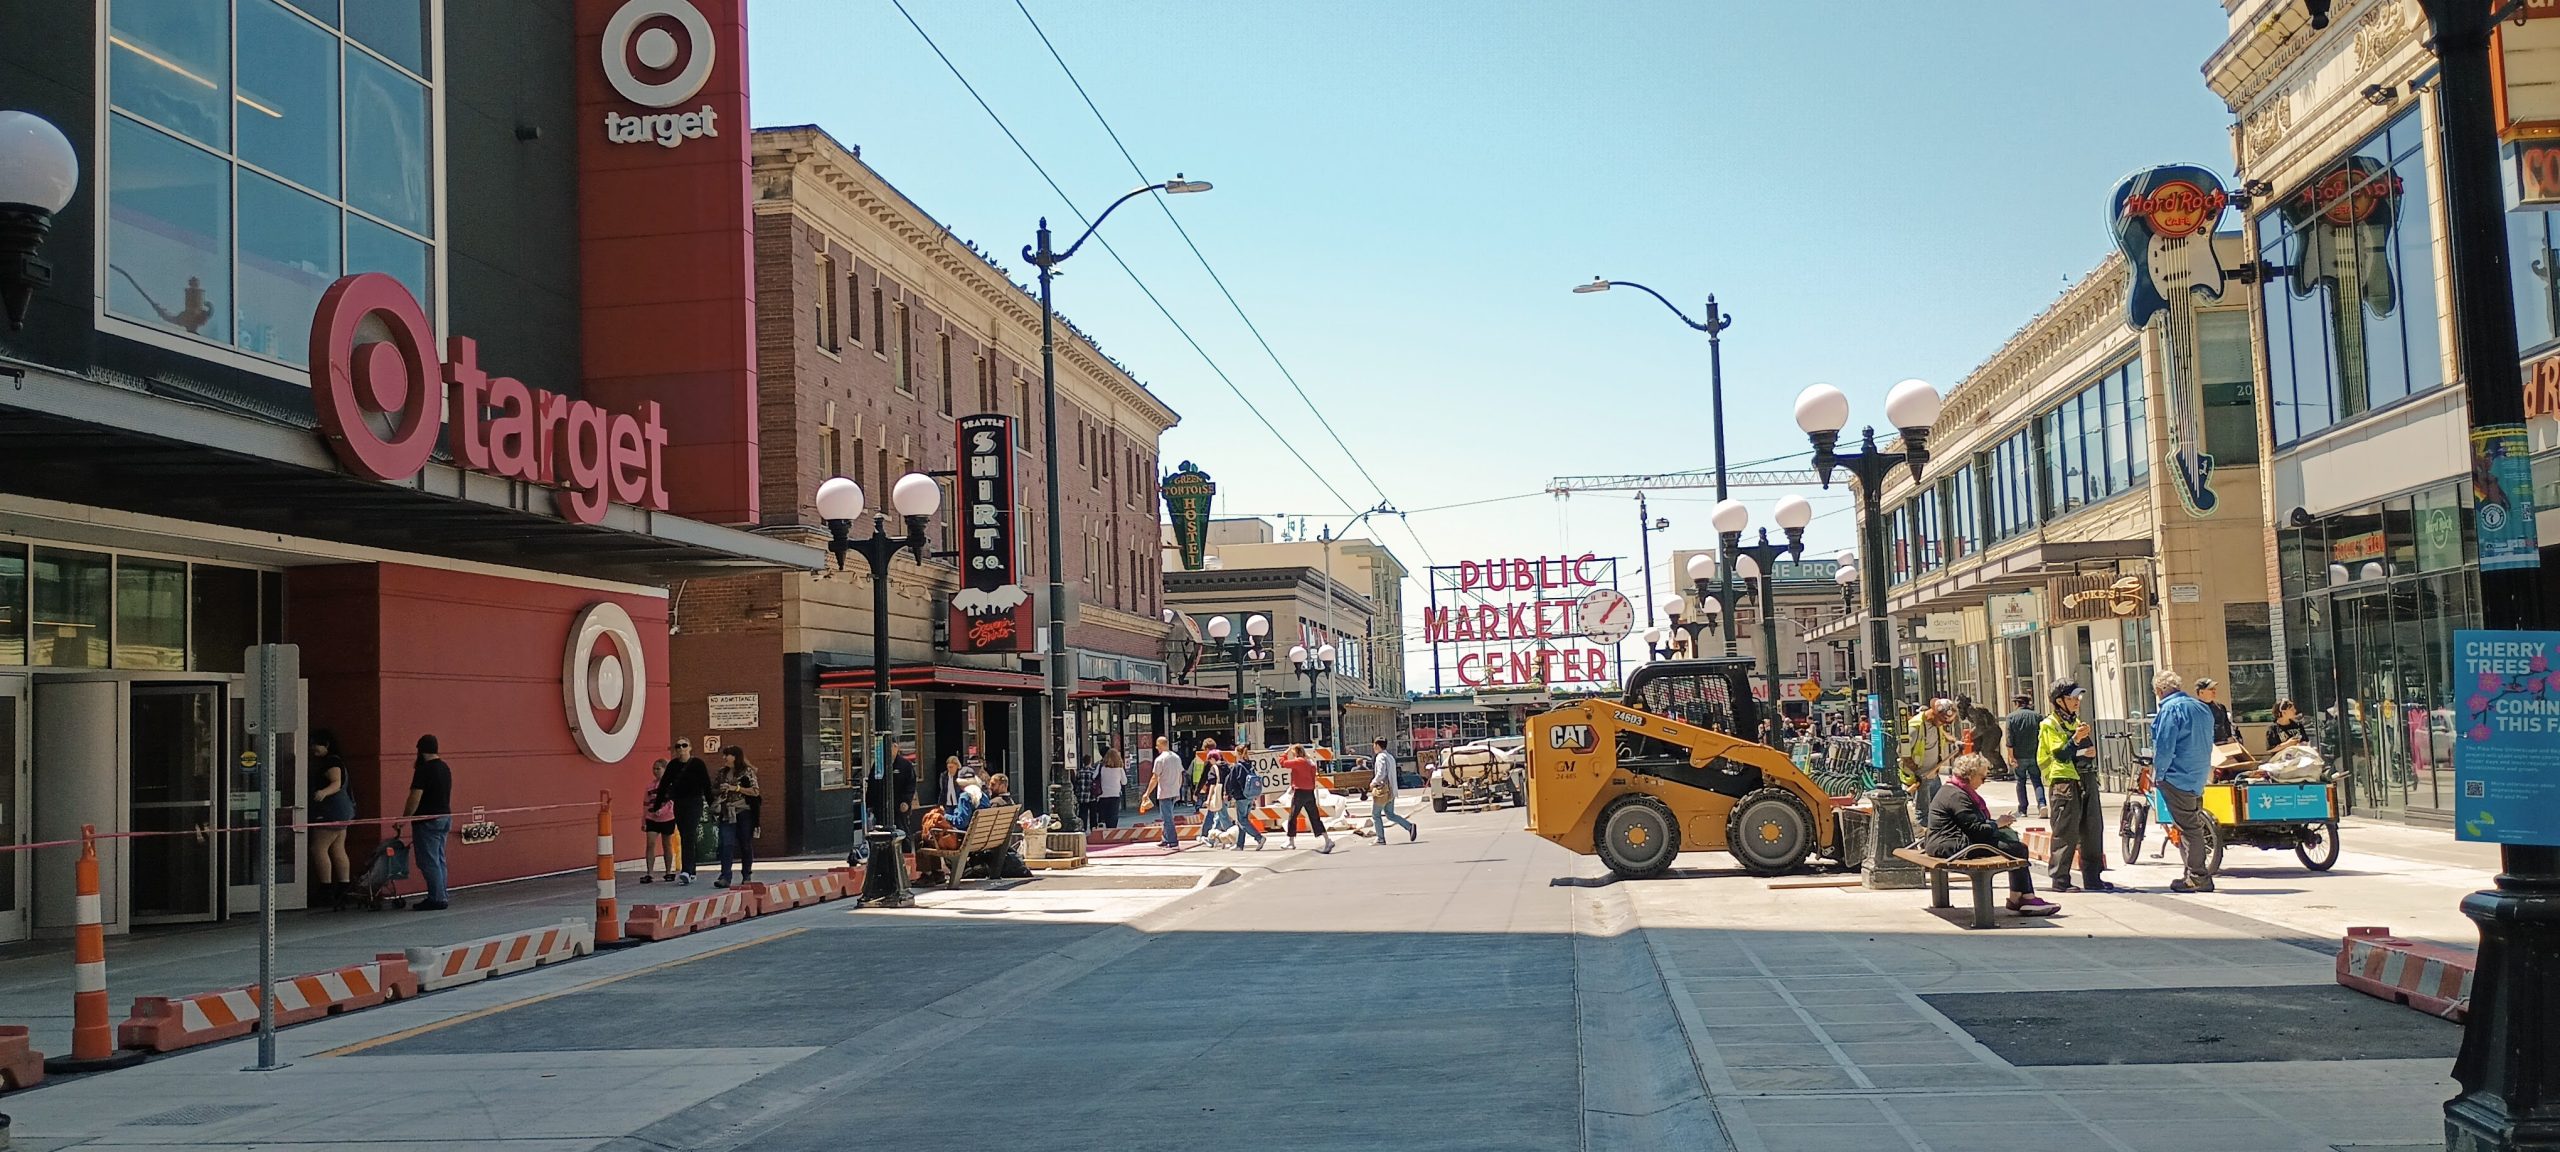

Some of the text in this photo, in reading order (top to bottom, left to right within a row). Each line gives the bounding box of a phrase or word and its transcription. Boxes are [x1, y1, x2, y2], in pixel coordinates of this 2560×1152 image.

[605, 104, 718, 148] target
[2128, 188, 2226, 214] Hard Rock
[448, 336, 668, 524] target
[962, 418, 1005, 430] SEATTLE
[1174, 474, 1203, 485] GREEN
[970, 430, 1000, 550] SHIRT
[1164, 484, 1215, 496] TORTOISE
[1184, 498, 1199, 566] HOSTEL
[1460, 553, 1597, 593] PUBLIC
[2074, 588, 2116, 603] LUKE'S
[1424, 598, 1577, 644] MARKET
[2465, 641, 2545, 657] CHERRY
[1457, 648, 1607, 686] CENTER
[2465, 658, 2531, 675] TREES
[1199, 713, 1230, 725] Market
[1613, 710, 1643, 726] 246D3
[2496, 716, 2560, 733] THIS F
[1550, 725, 1588, 749] CAT
[1250, 757, 1283, 771] ROA
